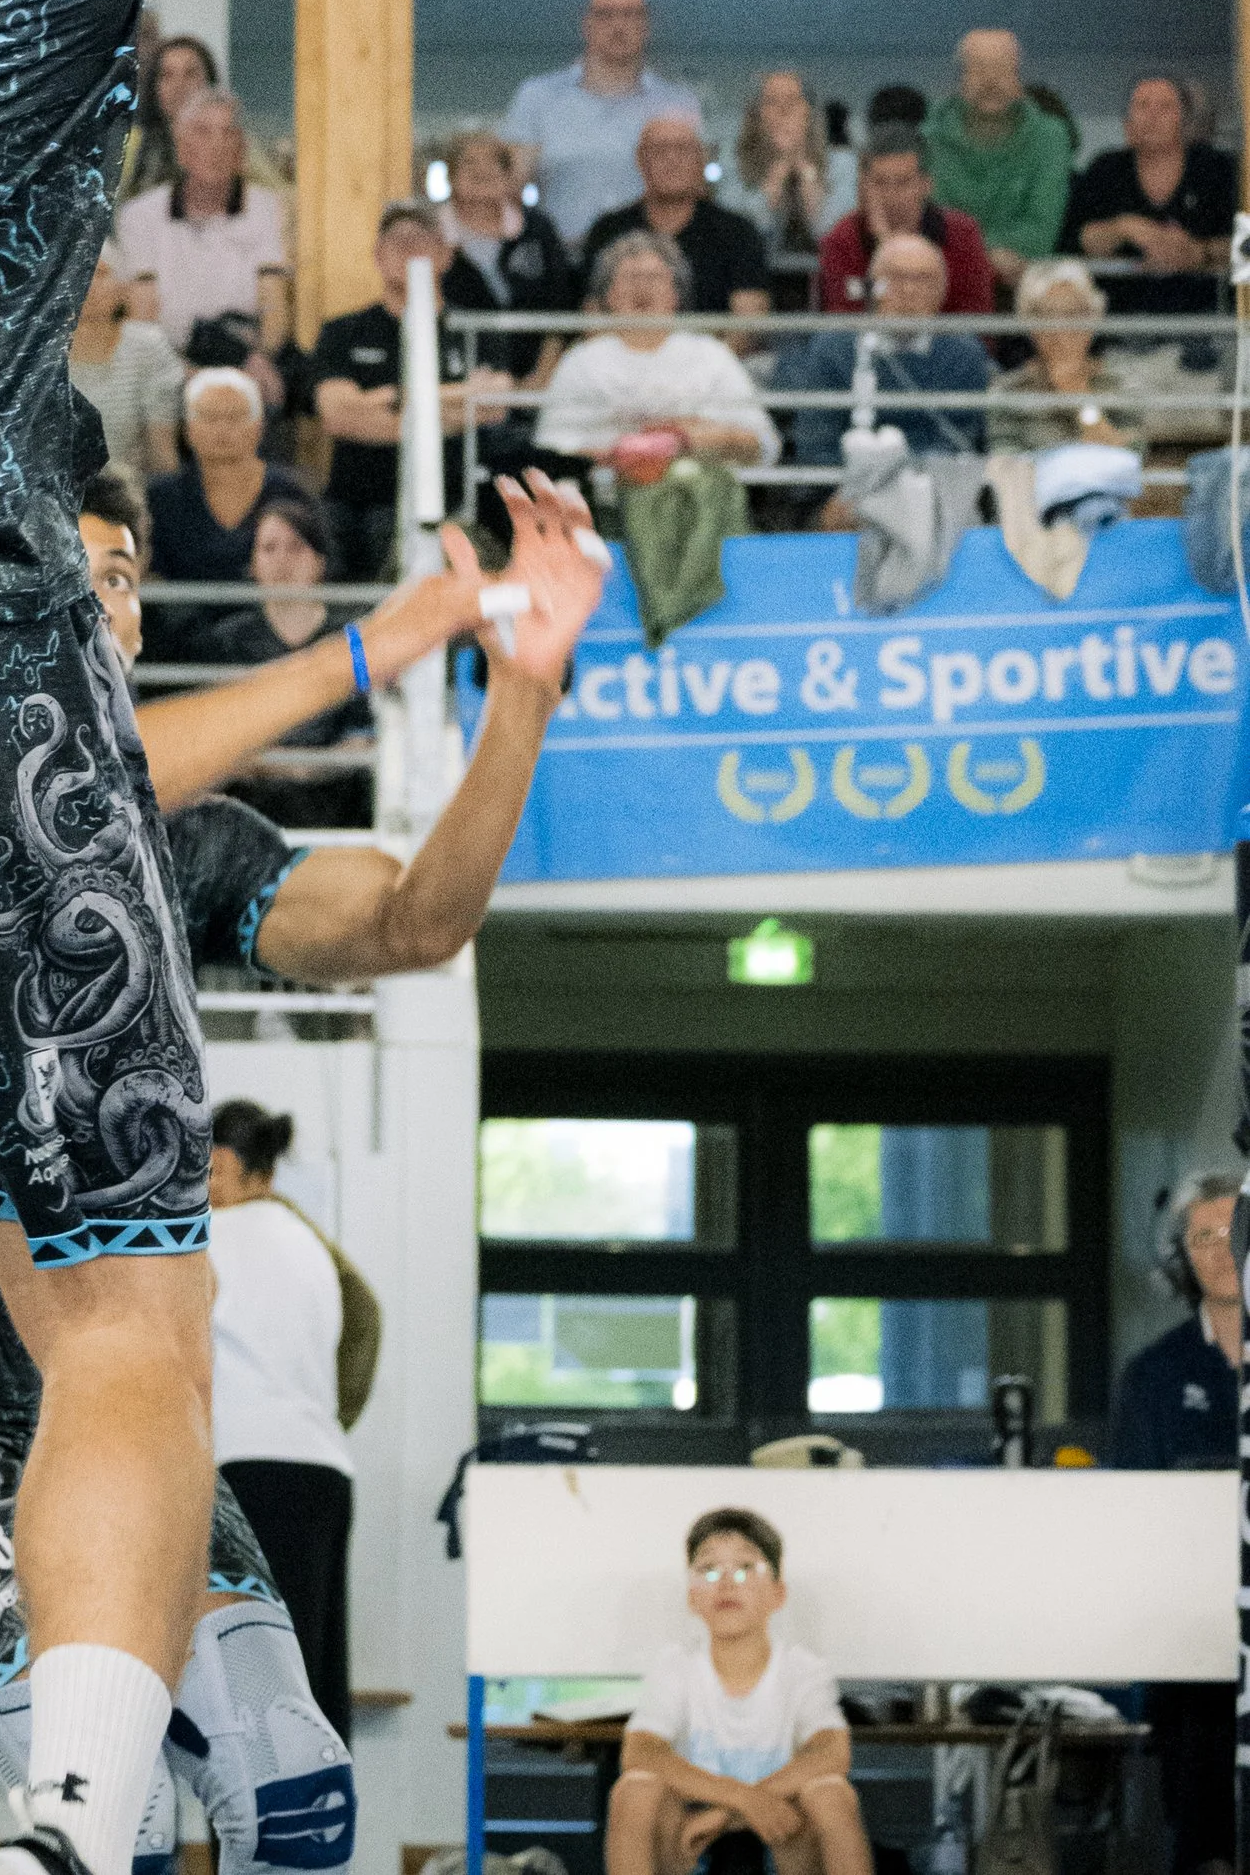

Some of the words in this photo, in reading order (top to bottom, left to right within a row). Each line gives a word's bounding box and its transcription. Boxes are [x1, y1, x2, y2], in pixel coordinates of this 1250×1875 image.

[557, 646, 782, 721] ctive
[800, 637, 858, 713] &
[877, 625, 1238, 725] Sportive
